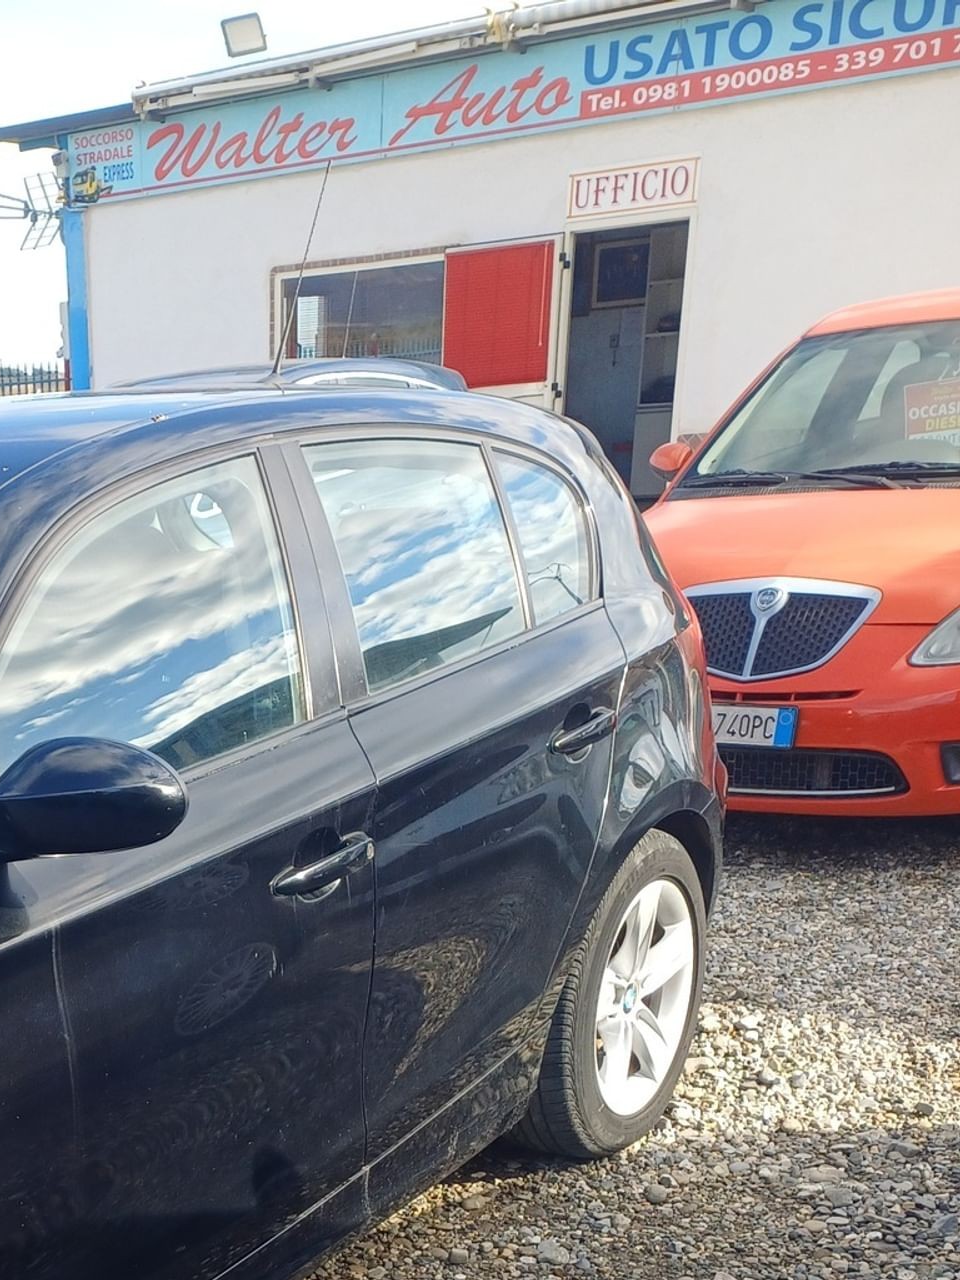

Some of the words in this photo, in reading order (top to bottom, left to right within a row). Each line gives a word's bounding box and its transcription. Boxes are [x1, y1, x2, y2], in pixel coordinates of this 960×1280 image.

[583, 14, 773, 85] USATO
[791, 0, 960, 51] SICU
[588, 89, 626, 112] Tel.
[633, 78, 691, 106] 0981
[700, 60, 811, 95] 1900085
[833, 47, 886, 73] 339
[892, 37, 942, 63] 701
[74, 128, 134, 150] SOCCORSO
[146, 105, 358, 182] Walter
[388, 63, 573, 146] Auto
[76, 145, 133, 166] STRADALE
[103, 161, 134, 183] EXPRESS
[573, 166, 690, 209] UFFICIO
